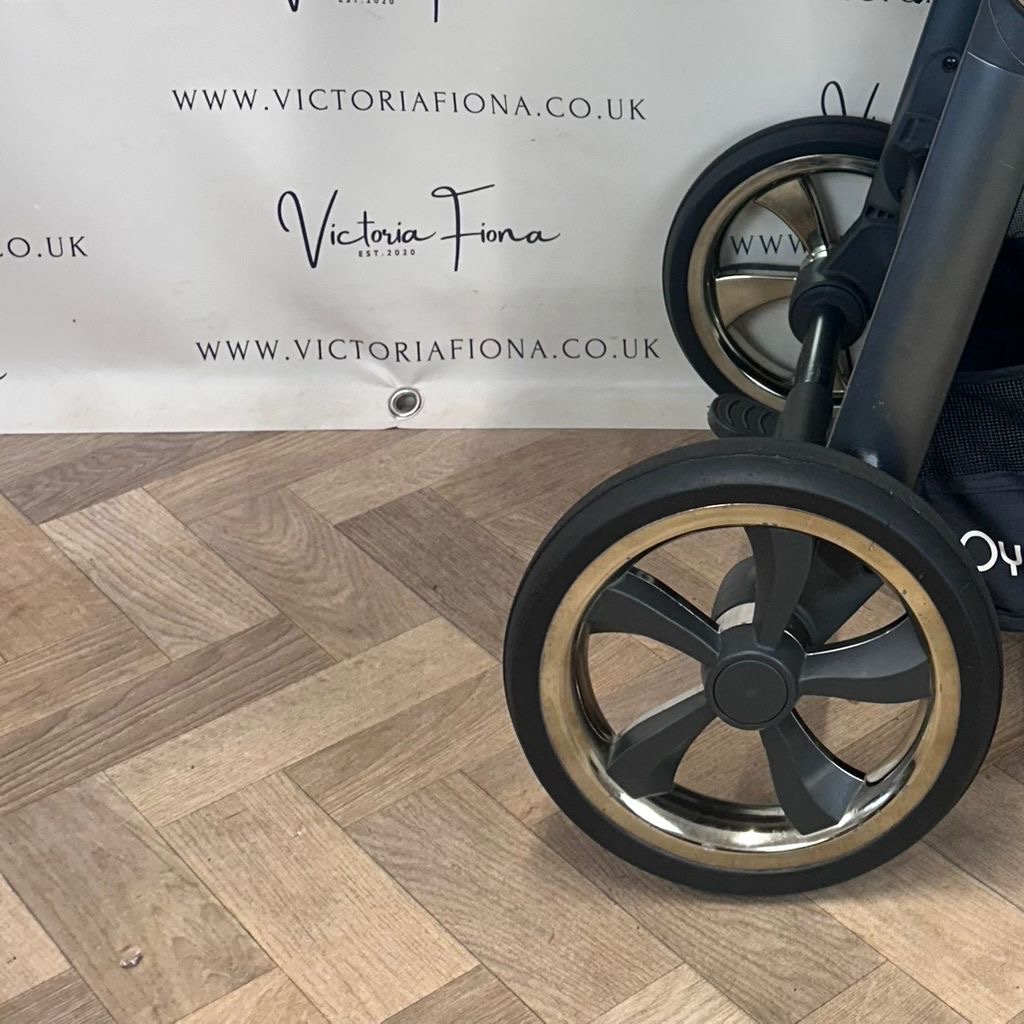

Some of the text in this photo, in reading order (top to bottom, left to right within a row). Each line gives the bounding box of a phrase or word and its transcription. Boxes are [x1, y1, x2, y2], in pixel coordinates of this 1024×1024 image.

[172, 88, 647, 121] WWW.VICTORIAFIONA.CO.UK
[277, 184, 561, 272] Victoria Fiona
[0, 236, 88, 257] O.UK
[196, 338, 661, 363] WWW.VICTORIAFIONA.CO.UK
